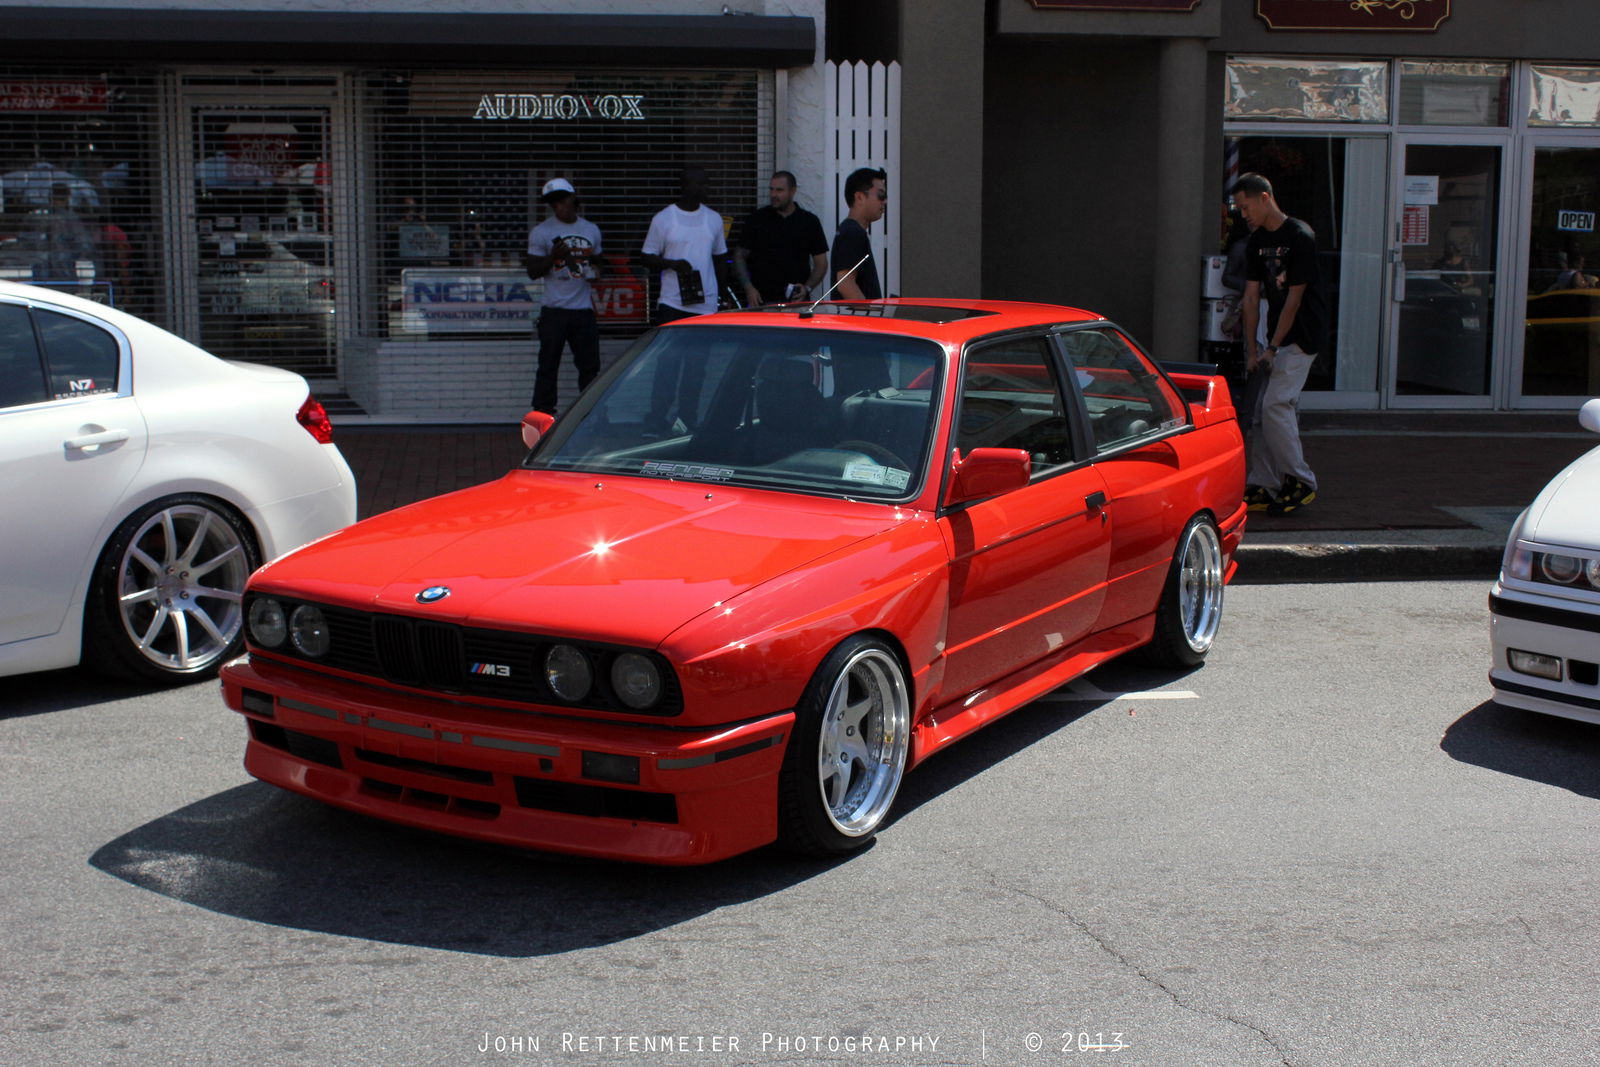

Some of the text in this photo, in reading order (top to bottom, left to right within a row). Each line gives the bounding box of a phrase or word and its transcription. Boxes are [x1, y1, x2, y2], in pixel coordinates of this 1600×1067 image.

[21, 84, 94, 97] SYSTEMS
[472, 94, 645, 119] AUDIOVOX
[1561, 212, 1593, 229] OPEN
[413, 282, 533, 303] NOKIA
[590, 286, 635, 315] VC
[69, 379, 92, 391] N7
[481, 663, 511, 677] M3
